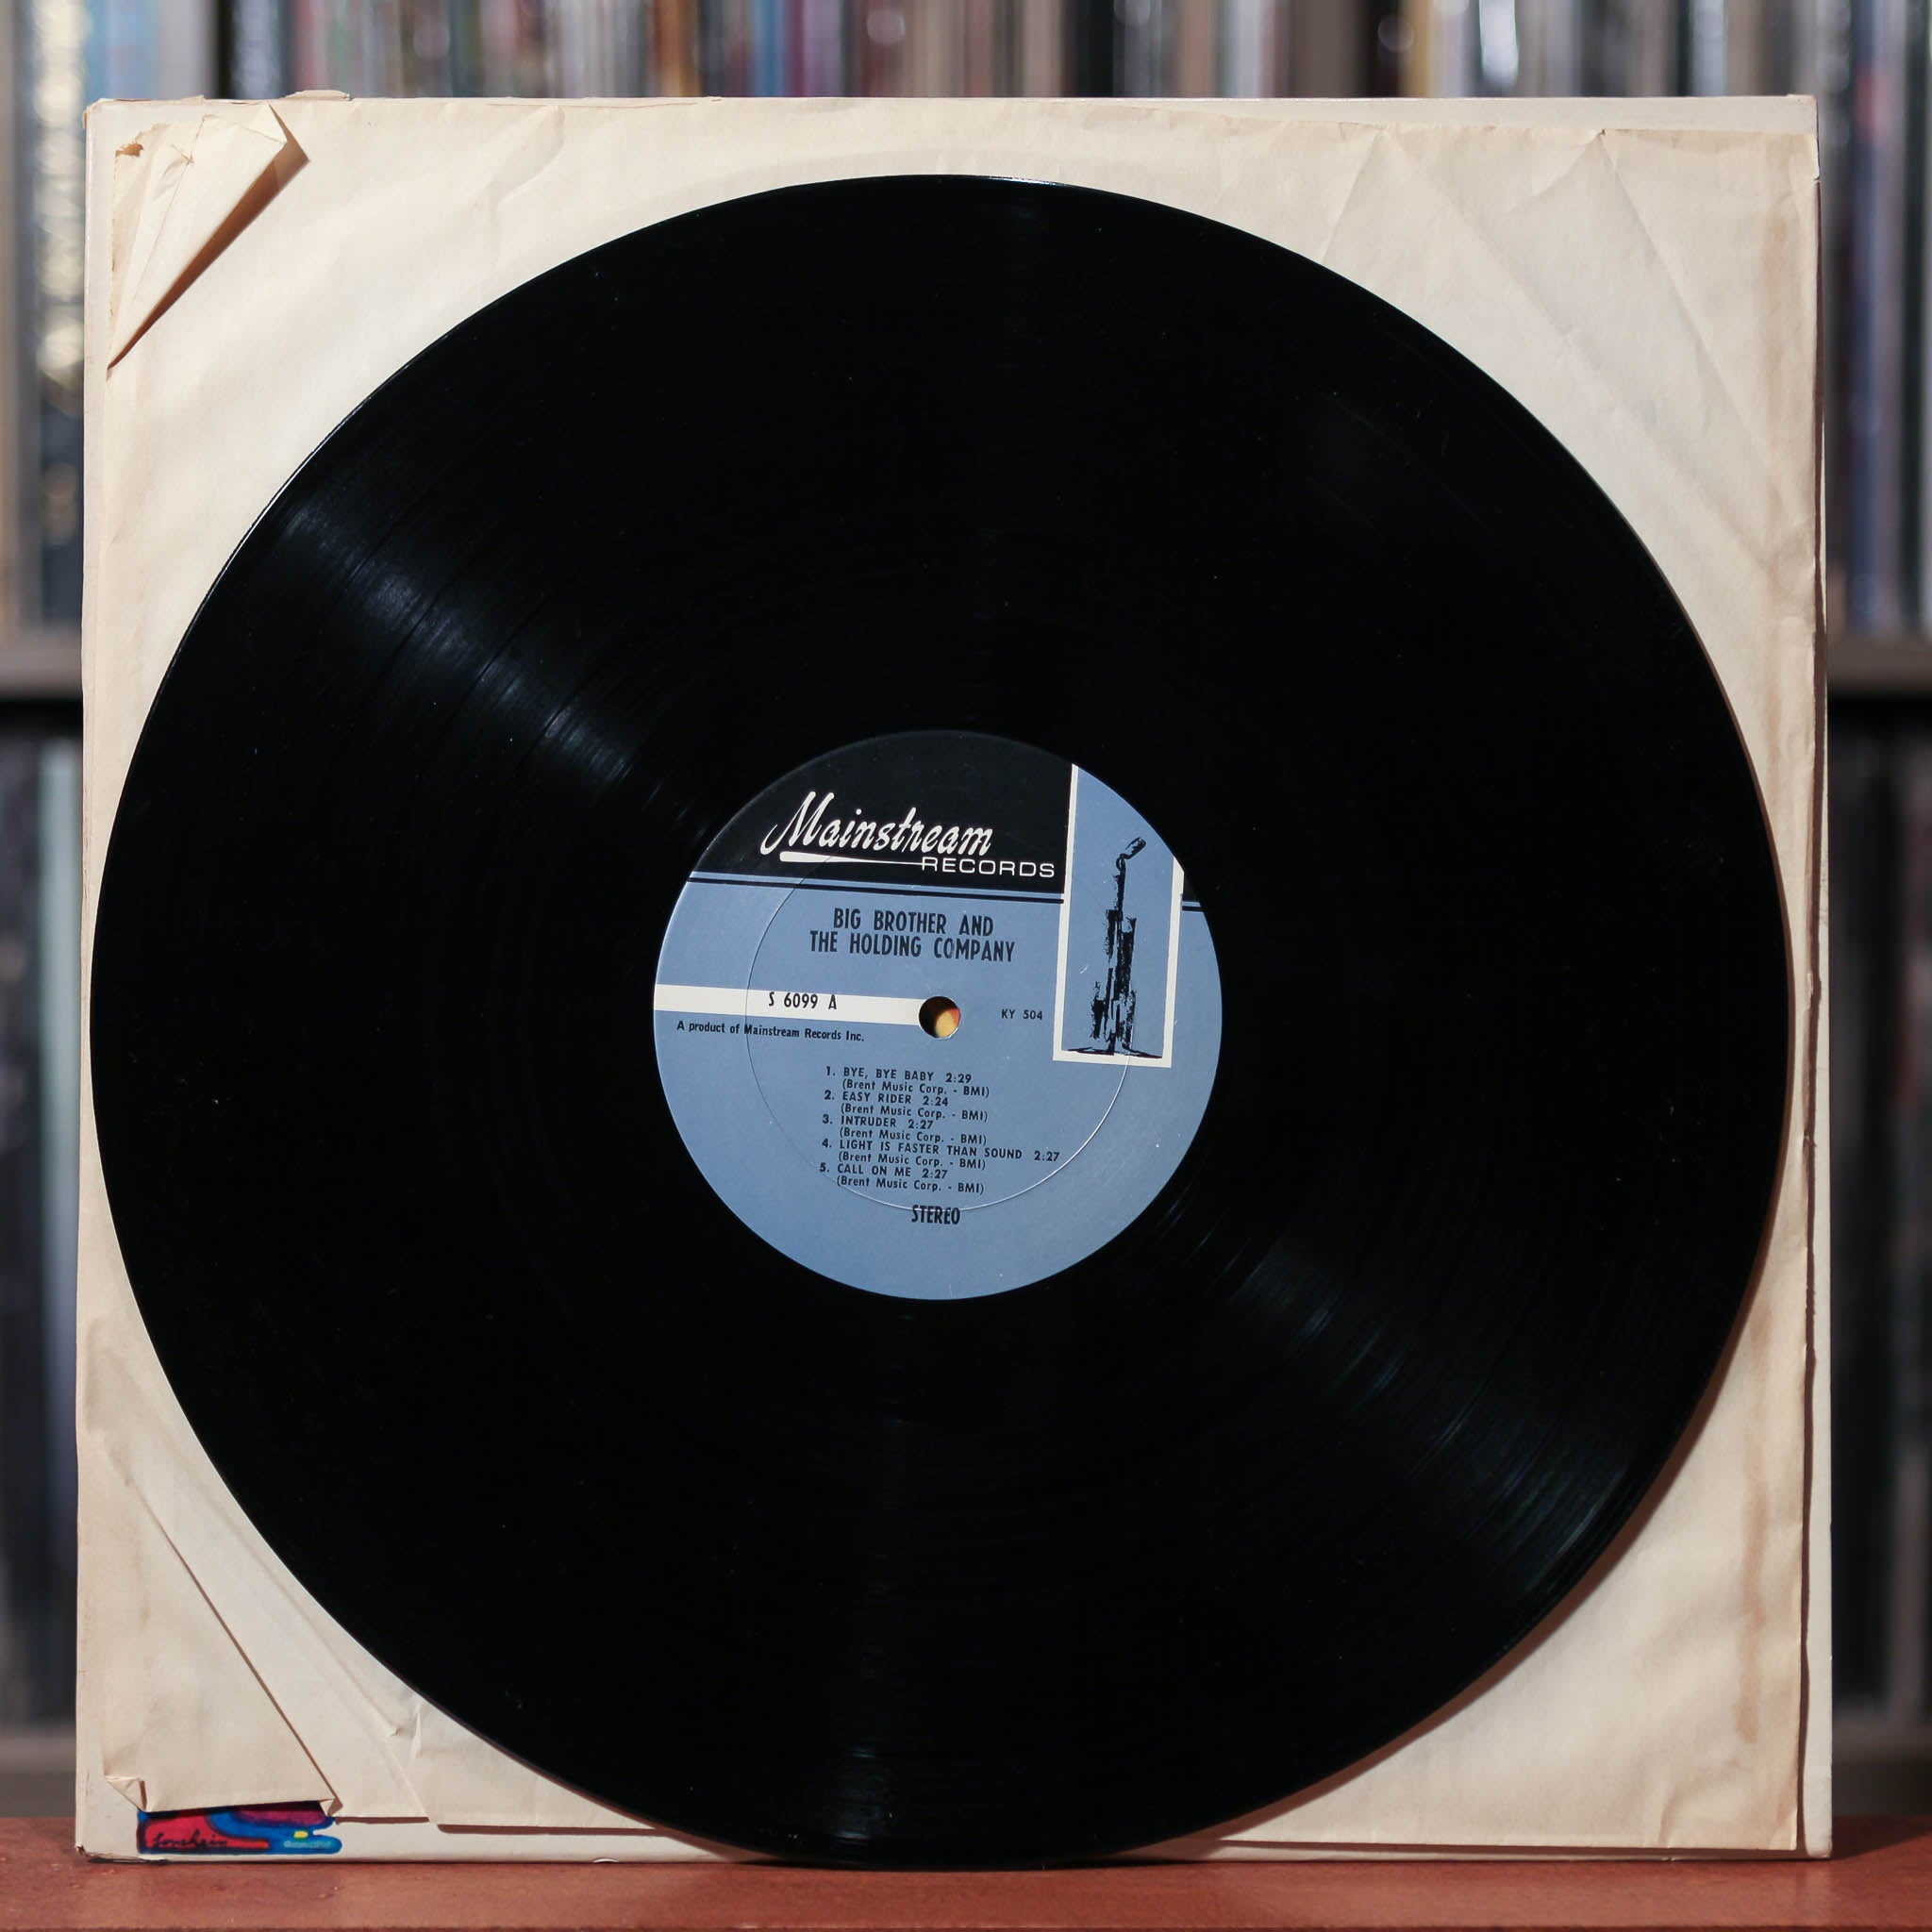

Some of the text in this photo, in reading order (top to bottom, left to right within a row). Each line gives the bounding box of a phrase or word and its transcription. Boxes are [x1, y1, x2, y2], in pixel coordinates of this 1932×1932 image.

[760, 791, 993, 855] Mainstream
[923, 856, 1055, 877] RECORDS
[834, 908, 993, 936] BIG BROTHER AND
[810, 931, 1015, 962] THE HOLDING COMPANY
[769, 991, 837, 1010] S 6099 A
[1002, 1008, 1042, 1020] KY 504
[677, 1020, 864, 1041] A product of Mainstream Records Inc.
[825, 1067, 972, 1083] 1. BYE, BYE BABY 2:29
[842, 1079, 875, 1090] (Brent
[882, 1081, 913, 1092] Music
[919, 1084, 947, 1095] Corp.
[963, 1086, 990, 1098] BMI)
[824, 1091, 948, 1107] 2. EASY RIDER 2:24
[823, 1114, 934, 1129] 3. INTRUDER 2:27
[841, 1103, 874, 1114] (Brent
[880, 1106, 911, 1117] Music
[918, 1108, 945, 1120] Corp.
[961, 1110, 988, 1123] BMI)
[840, 1127, 873, 1139] (Brent
[879, 1130, 910, 1141] Music
[916, 1132, 943, 1143] Corp.
[961, 1135, 987, 1146] BMI)
[822, 1139, 1060, 1161] 4. LIGHT IS FASTER THAN SOUND 2:27
[839, 1152, 872, 1163] (Brent
[878, 1154, 909, 1166] Music
[915, 1157, 942, 1168] Corp.
[959, 1159, 986, 1170] BMI)
[820, 1163, 948, 1179] 5. CALL ON ME 2:27
[837, 1175, 870, 1188] (Brent
[876, 1178, 908, 1190] Music
[914, 1181, 941, 1192] Corp.
[958, 1183, 984, 1195] BMI)
[911, 1204, 960, 1224] STEREO
